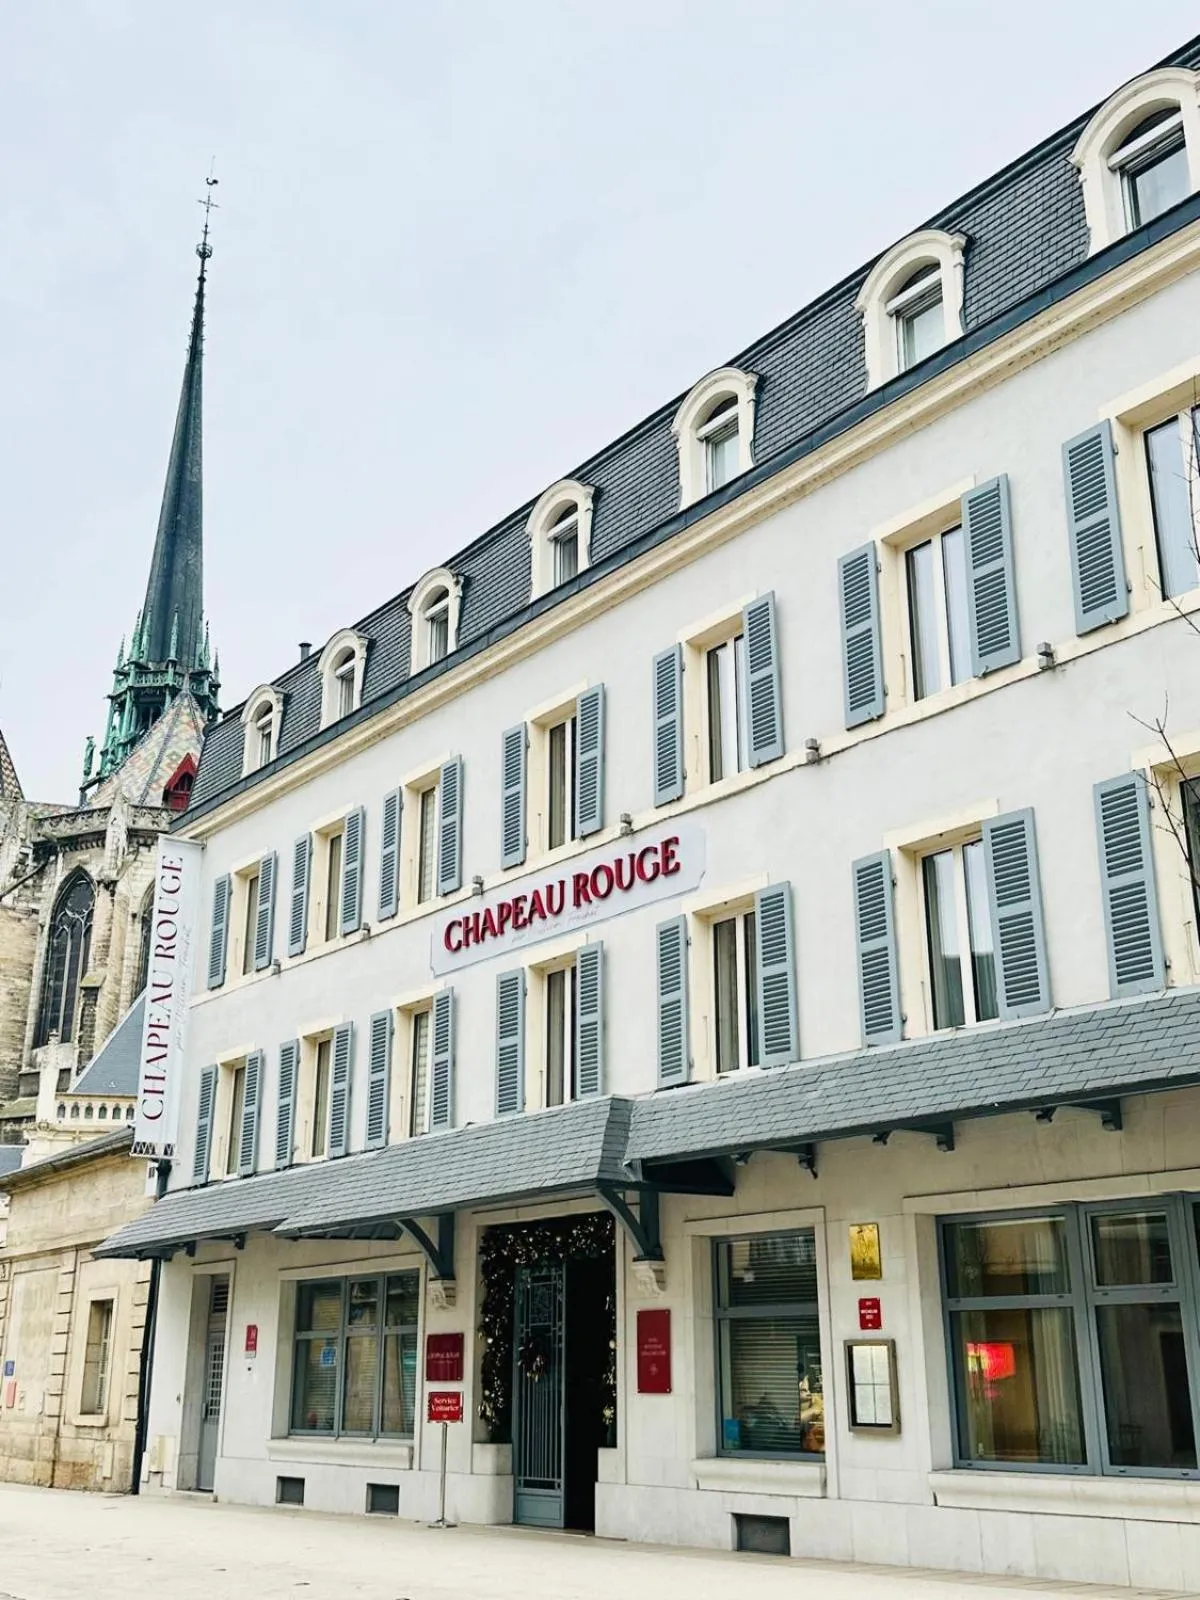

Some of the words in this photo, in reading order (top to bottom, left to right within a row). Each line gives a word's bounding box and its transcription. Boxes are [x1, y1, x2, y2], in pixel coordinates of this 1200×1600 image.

[154, 855, 183, 960] ROUGE
[444, 879, 565, 952] CHAPEAU
[572, 836, 681, 907] ROUGE
[142, 969, 174, 1121] CHAPEAU
